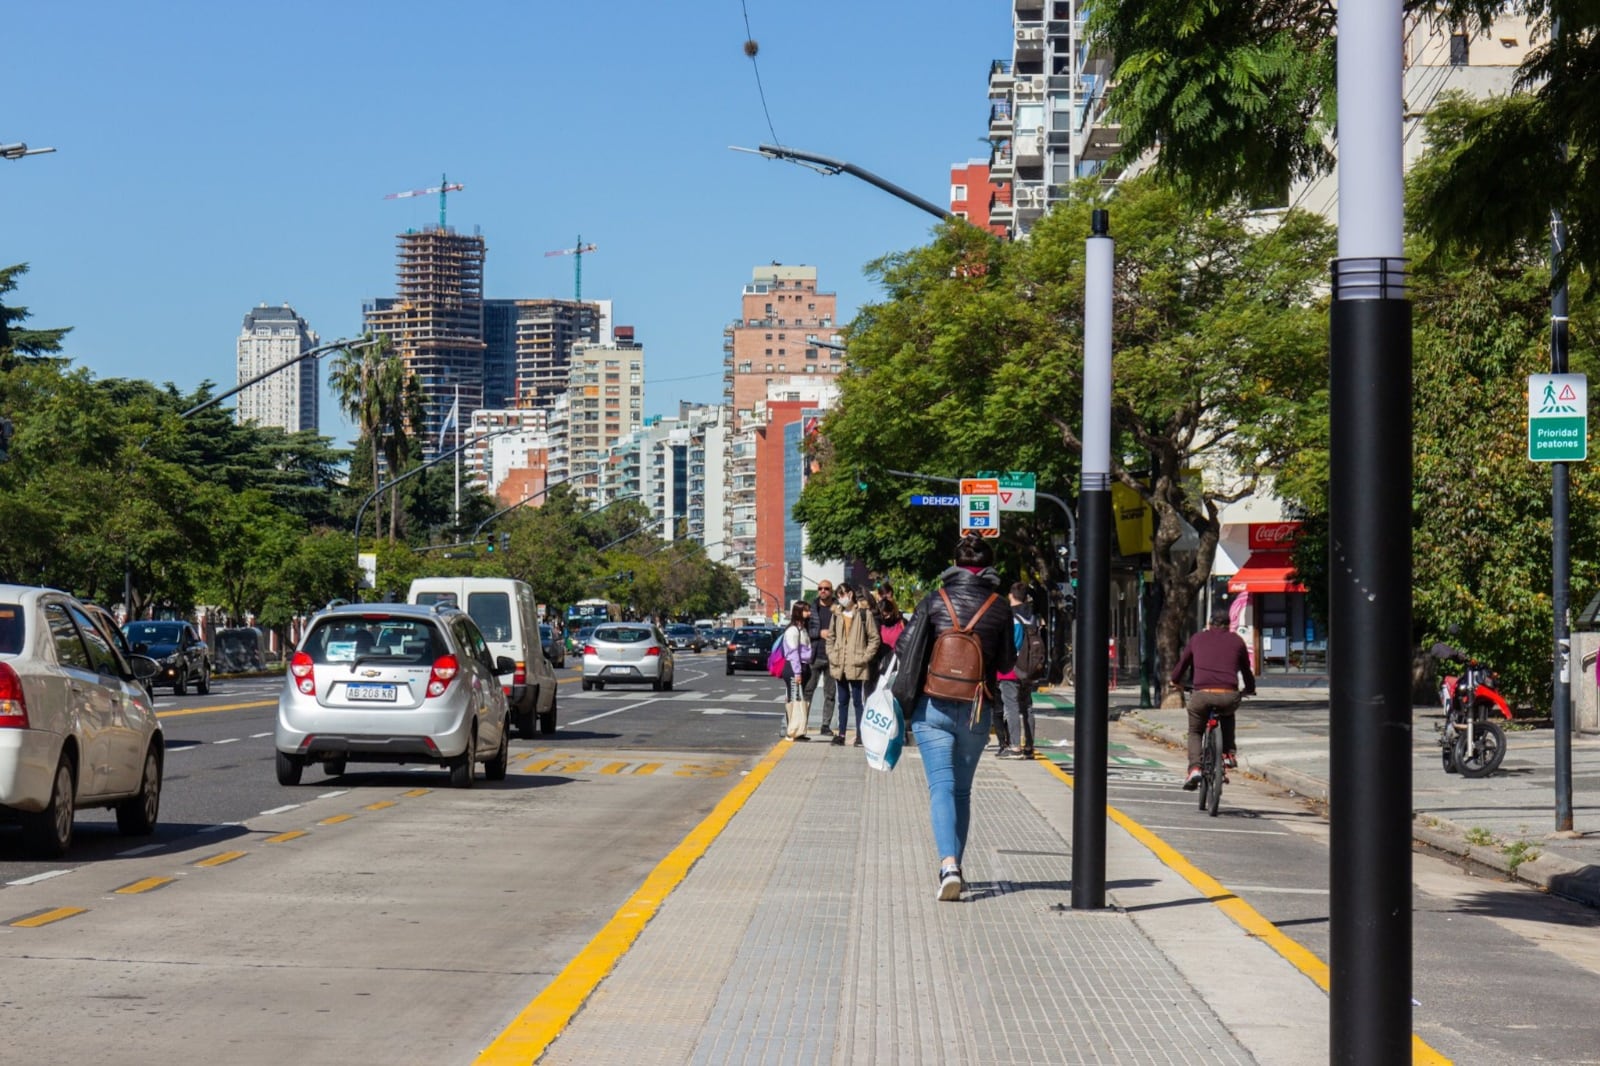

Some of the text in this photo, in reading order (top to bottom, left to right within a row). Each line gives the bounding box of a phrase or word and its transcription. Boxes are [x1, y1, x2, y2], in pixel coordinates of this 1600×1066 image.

[1537, 428, 1578, 437] Prioridad
[1536, 440, 1578, 449] peatones
[922, 496, 960, 506] DEHEZA
[974, 501, 985, 510] 15
[974, 517, 985, 526] 29
[348, 688, 360, 698] AB
[865, 708, 893, 731] OSSI
